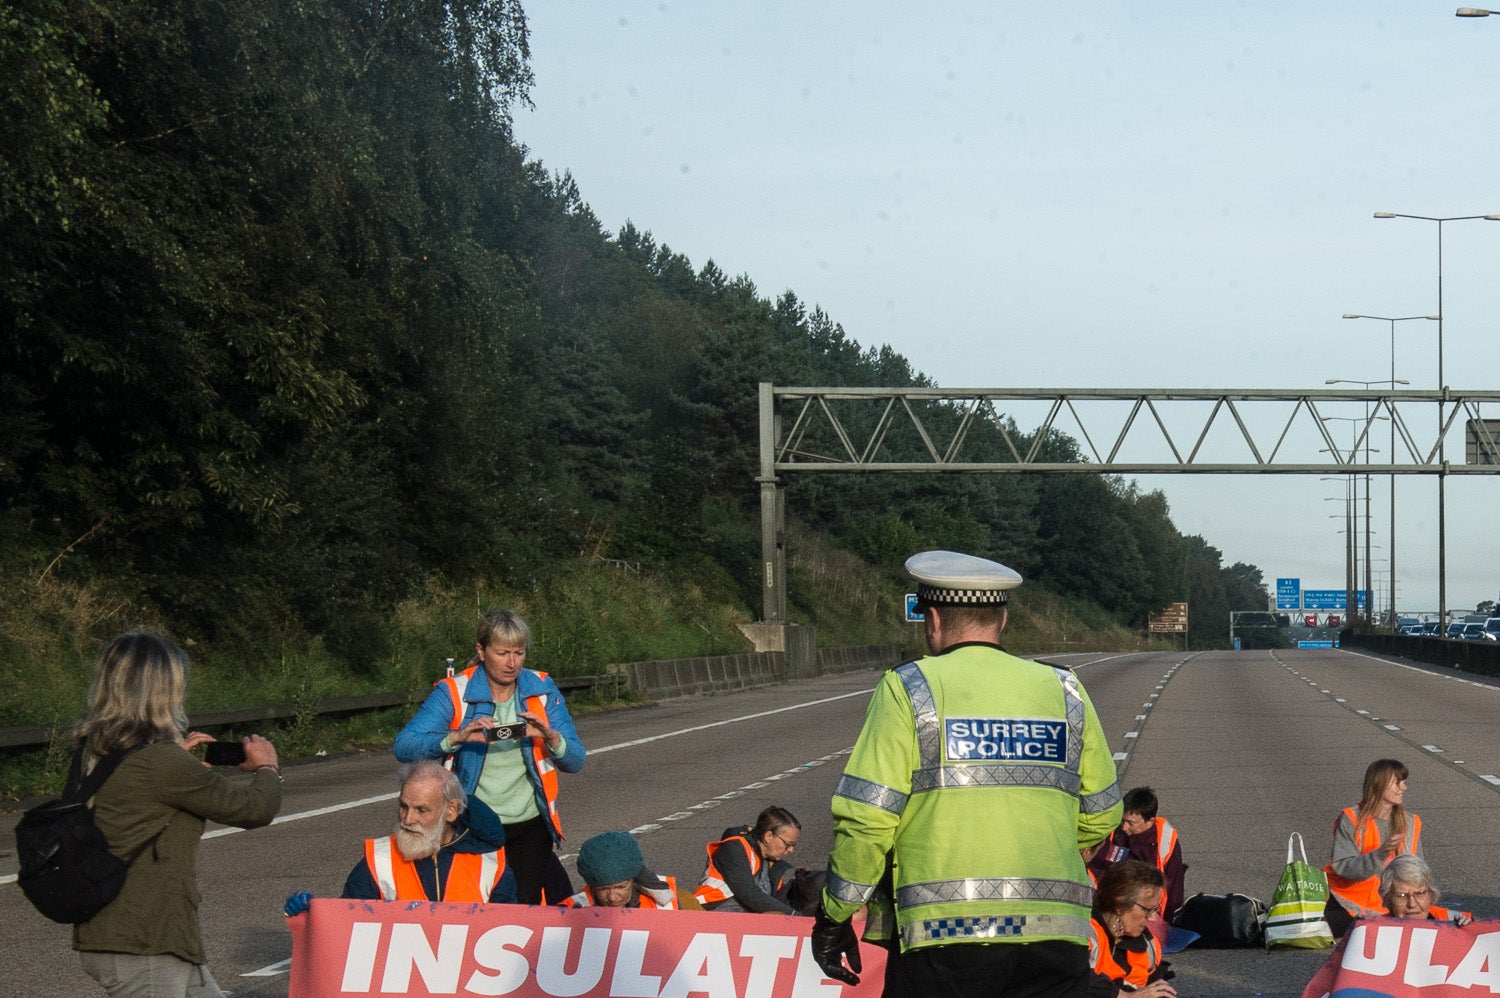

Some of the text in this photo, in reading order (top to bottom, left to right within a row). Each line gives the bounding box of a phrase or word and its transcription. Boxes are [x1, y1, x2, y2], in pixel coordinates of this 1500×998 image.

[951, 722, 1062, 740] SURREY
[957, 740, 1058, 759] POLICE
[1278, 880, 1325, 892] WATROSE
